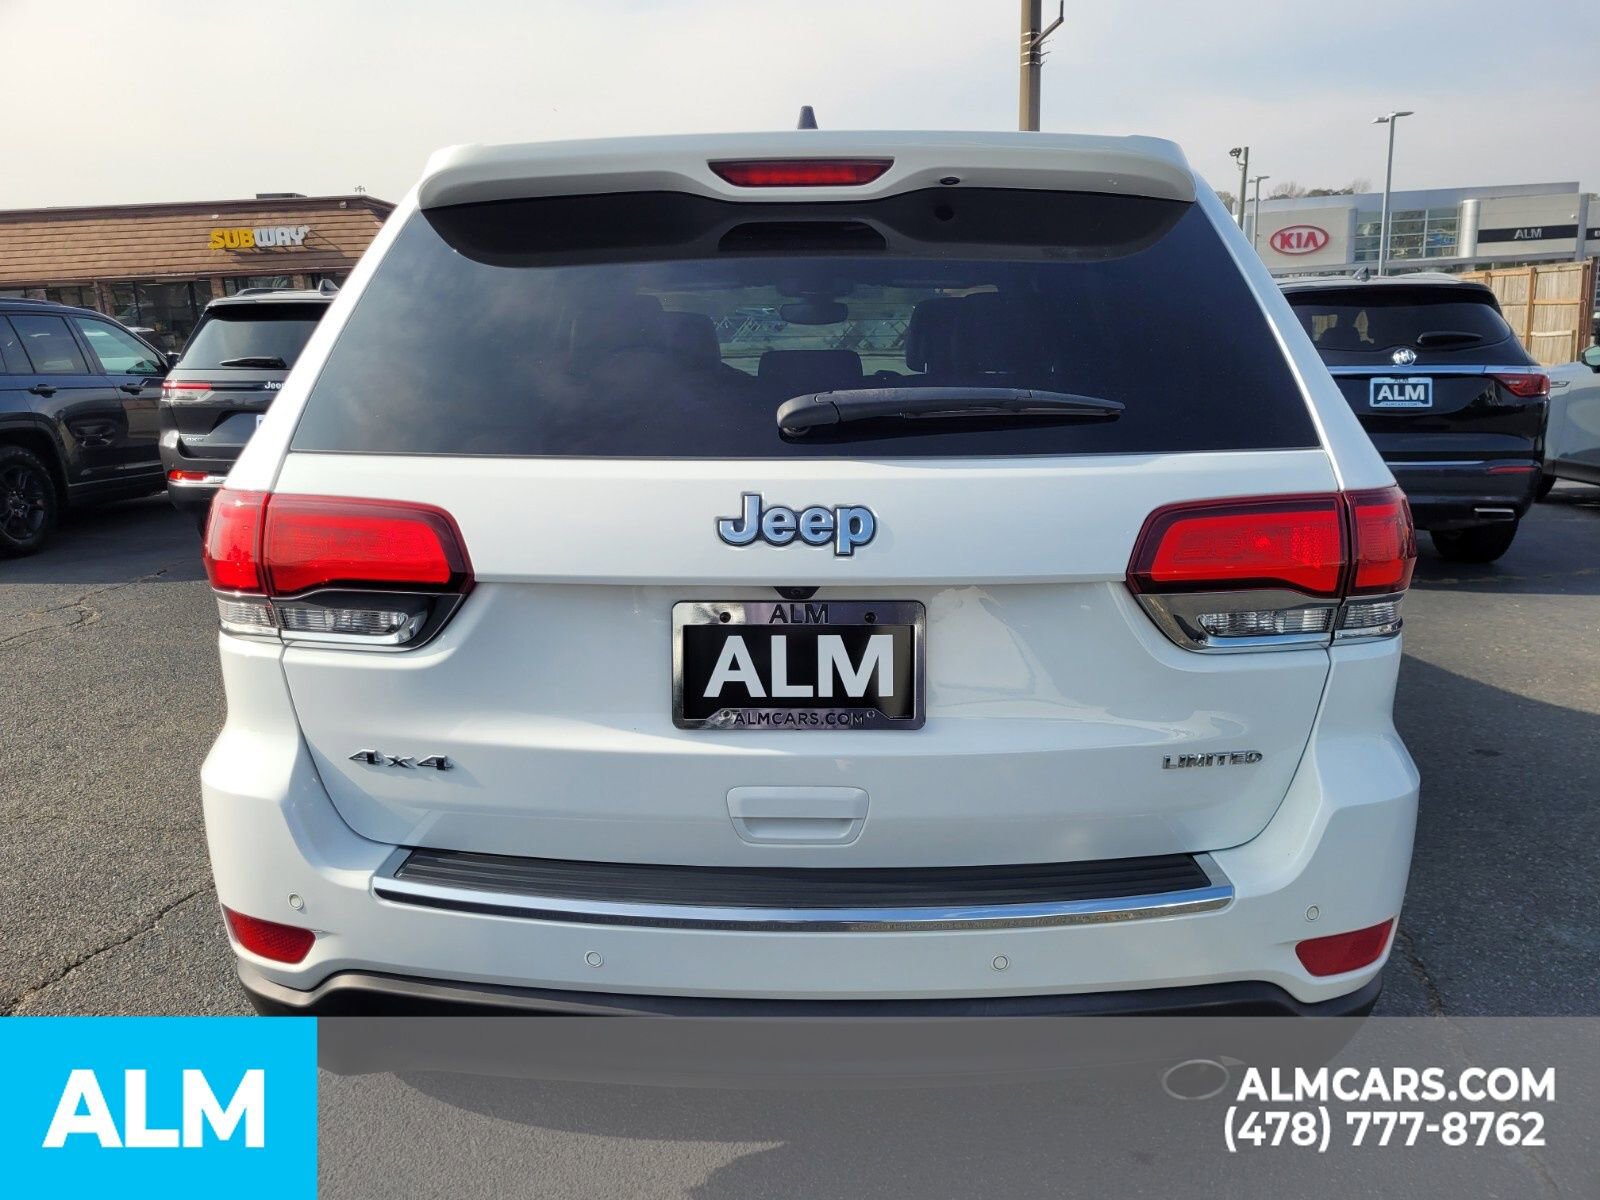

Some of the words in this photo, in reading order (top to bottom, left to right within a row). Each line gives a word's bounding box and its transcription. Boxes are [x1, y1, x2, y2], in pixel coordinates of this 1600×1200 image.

[208, 225, 310, 250] SUBWAY
[1280, 231, 1319, 249] KIA
[1514, 228, 1542, 240] ALM
[1377, 384, 1425, 401] ALM
[717, 494, 876, 556] Jeep
[769, 604, 829, 624] ALM
[703, 634, 894, 698] ALM
[734, 711, 865, 726] ALMCARS.COM
[348, 748, 455, 771] 4x4
[1162, 750, 1263, 769] LIMITED
